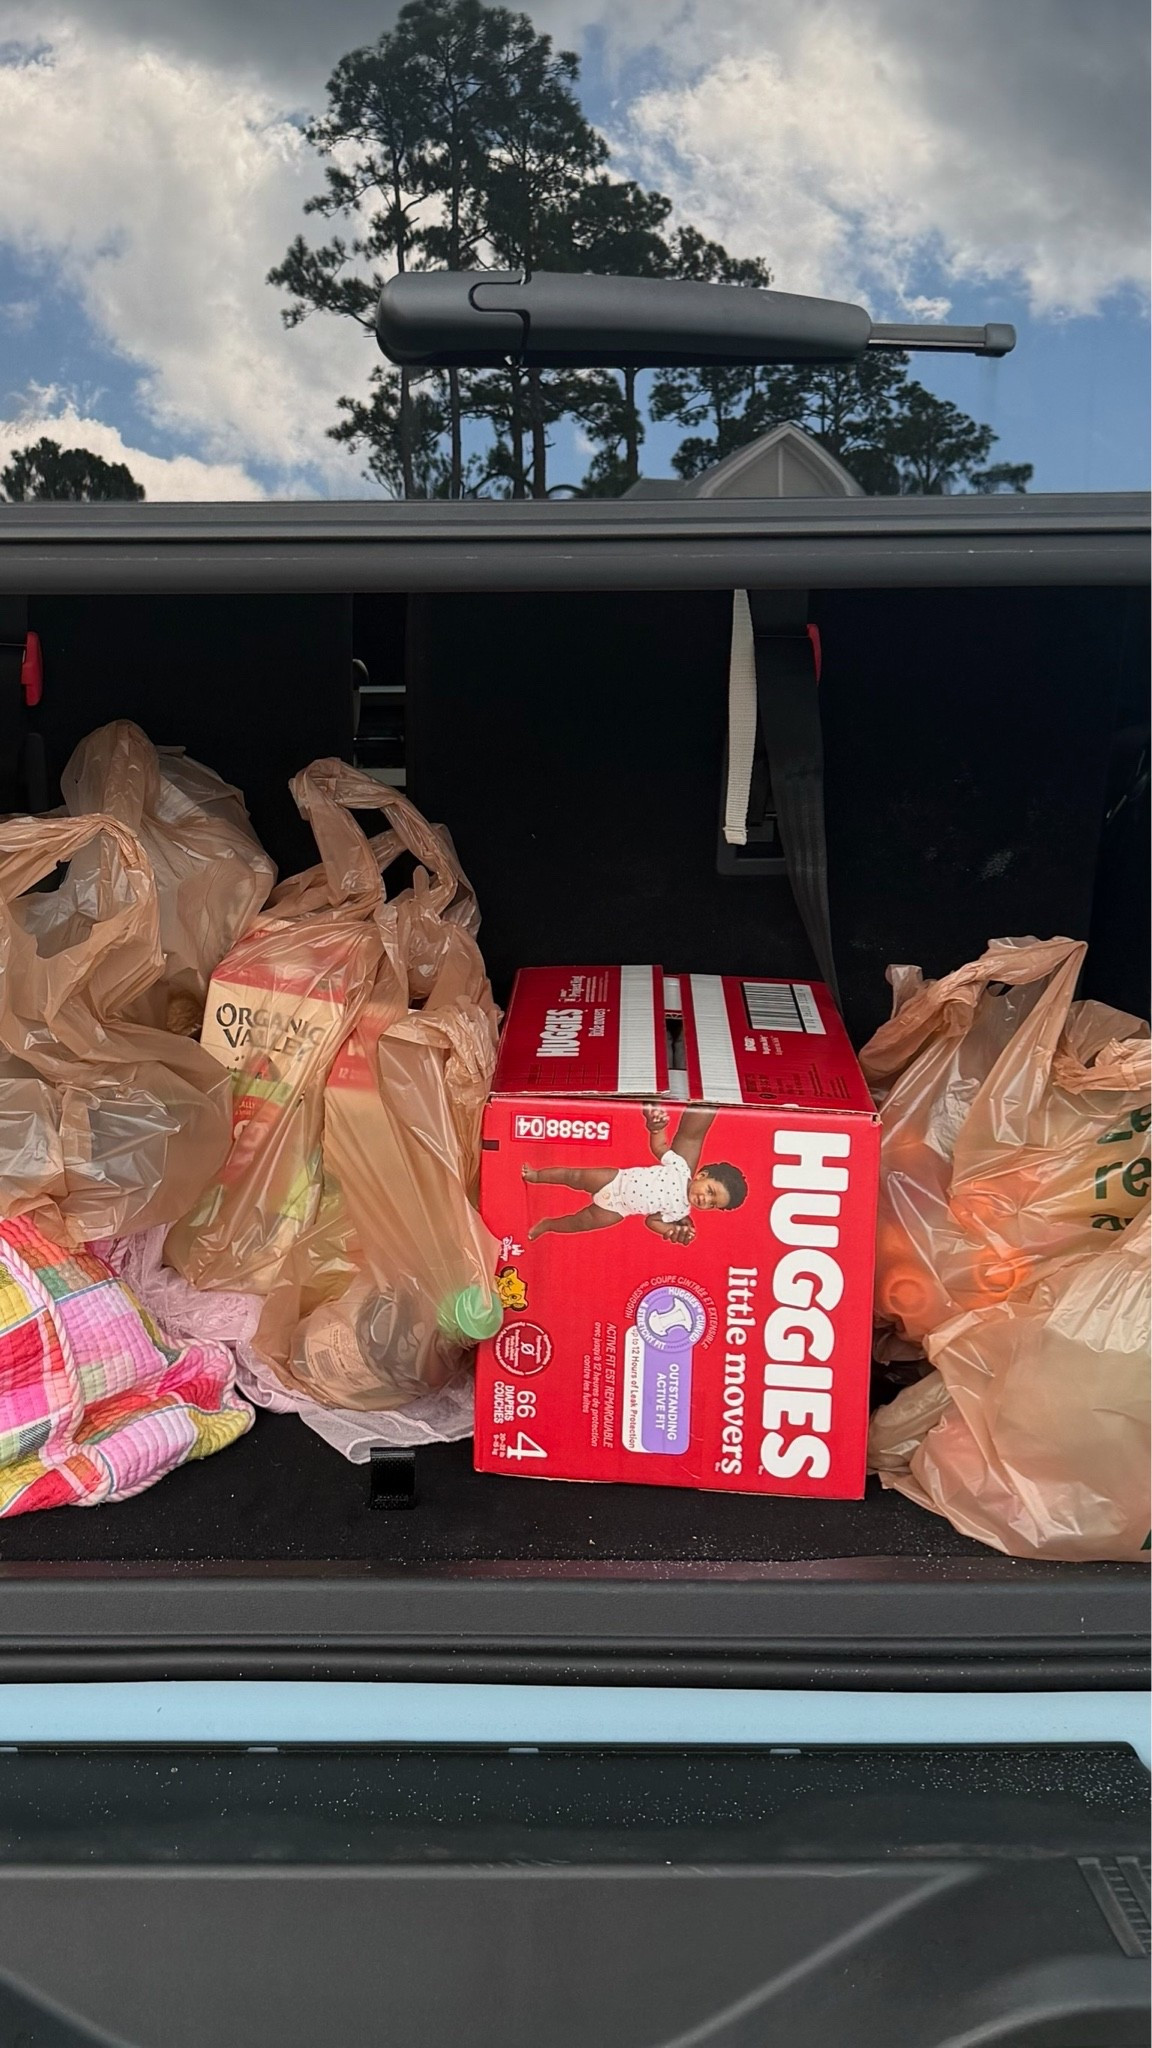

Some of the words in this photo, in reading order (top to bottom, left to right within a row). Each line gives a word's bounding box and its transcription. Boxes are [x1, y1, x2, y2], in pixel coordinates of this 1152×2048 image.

[216, 1003, 326, 1045] ORGANIC
[536, 1009, 583, 1057] HUGGIES
[518, 1117, 543, 1137] 04
[546, 1119, 610, 1140] 53588
[650, 1275, 677, 1286] COUPE
[704, 1297, 715, 1307] ET
[725, 1266, 758, 1346] little
[760, 1130, 851, 1479] HUGGIES
[594, 1321, 602, 1338] avec
[605, 1322, 617, 1354] ACTIVE
[637, 1308, 656, 1343] STRETCHY
[689, 1314, 706, 1342] CURVED
[701, 1307, 719, 1350] EXTENSIBLE
[631, 1338, 639, 1346] to
[631, 1346, 640, 1355] 12
[653, 1340, 667, 1350] FIT
[583, 1354, 592, 1380] contre
[593, 1362, 602, 1372] 12
[605, 1353, 616, 1368] FIT
[631, 1356, 639, 1379] Hours
[582, 1380, 592, 1391] les
[592, 1371, 602, 1398] heures
[604, 1368, 616, 1385] EST
[631, 1380, 639, 1388] of
[493, 1381, 505, 1424] COUCHES
[504, 1385, 515, 1422] DIAPERS
[516, 1390, 537, 1418] 66
[582, 1392, 592, 1414] fuites
[591, 1397, 601, 1408] de
[630, 1389, 638, 1408] Leak
[656, 1372, 667, 1411] ACTIVE
[667, 1363, 680, 1441] OUTSTANDING
[590, 1408, 600, 1447] protection
[603, 1385, 615, 1449] REMARQUABLE
[655, 1413, 665, 1430] FIT
[720, 1353, 746, 1476] movers
[628, 1409, 638, 1448] Protection
[506, 1431, 548, 1461] 4
